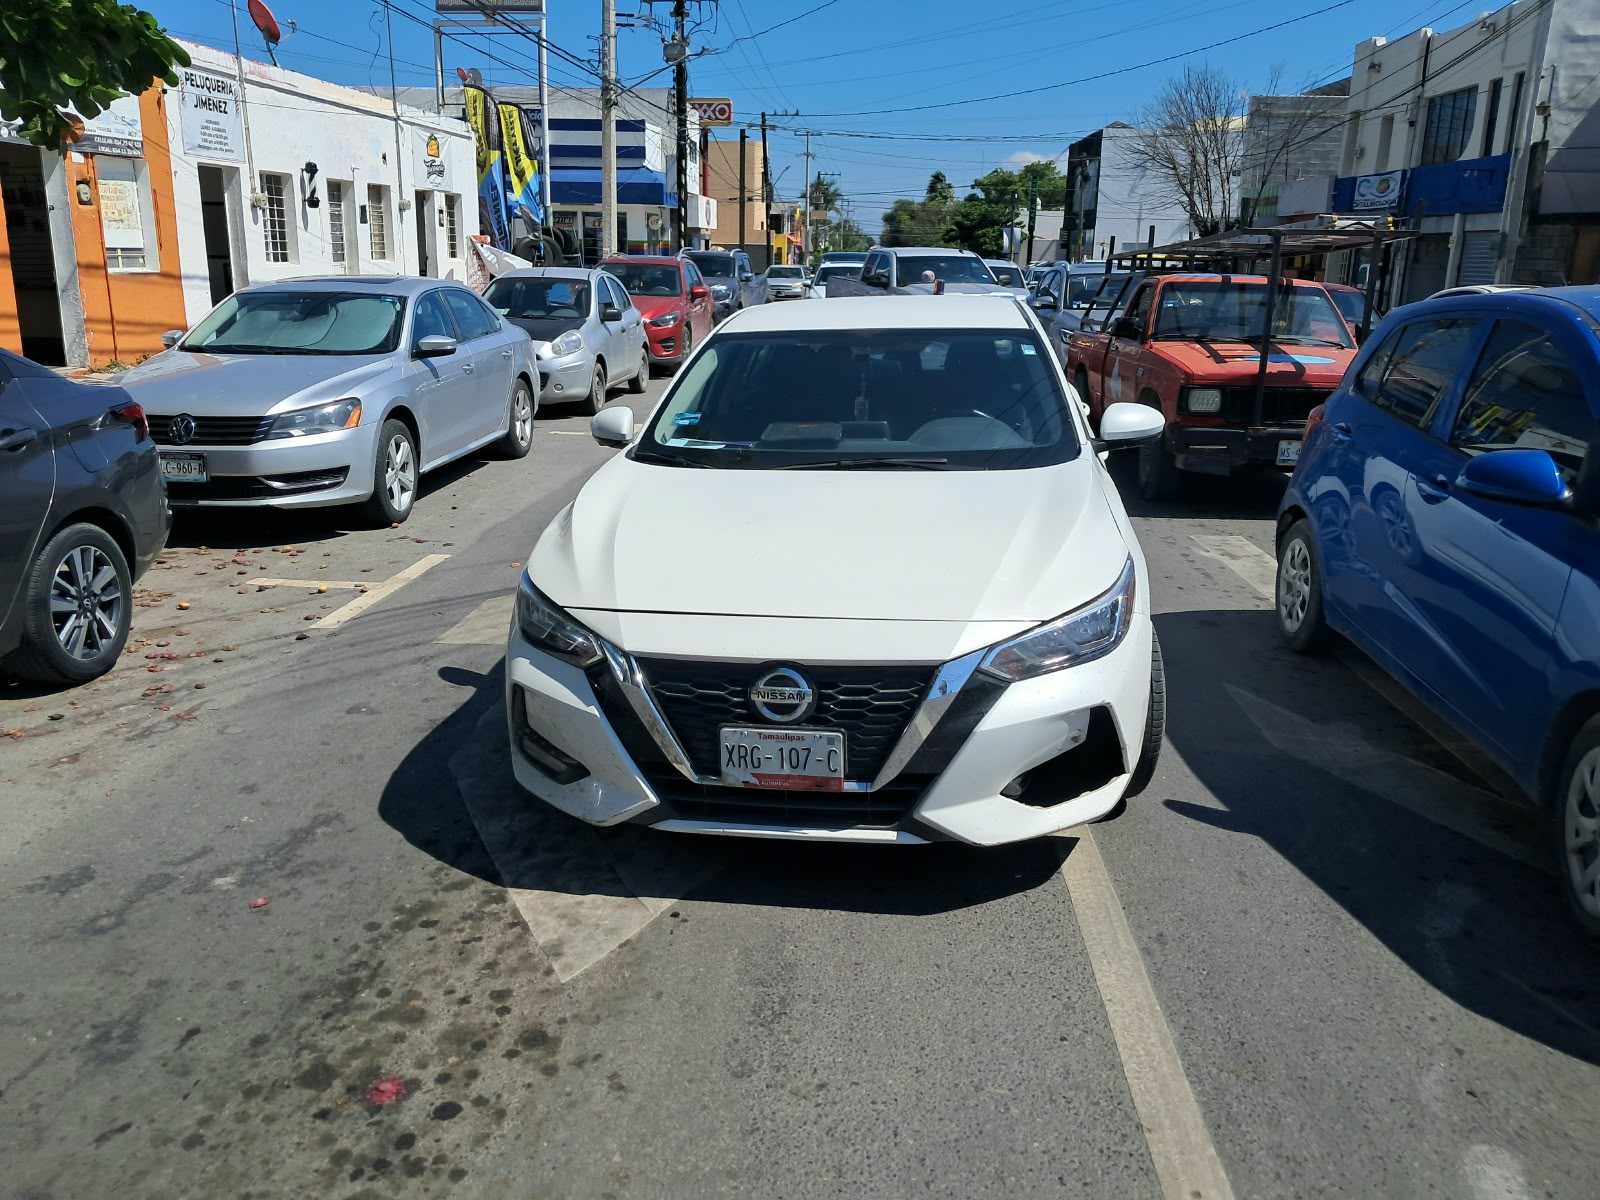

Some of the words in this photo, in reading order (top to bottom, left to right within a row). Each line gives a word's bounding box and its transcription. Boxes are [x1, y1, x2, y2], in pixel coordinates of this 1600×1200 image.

[184, 71, 234, 96] PELUQUERIA
[193, 94, 228, 114] JIMENEZ
[757, 690, 806, 701] NISSAN
[758, 732, 806, 741] Tamaulipas
[724, 742, 839, 773] XRG-107-C
